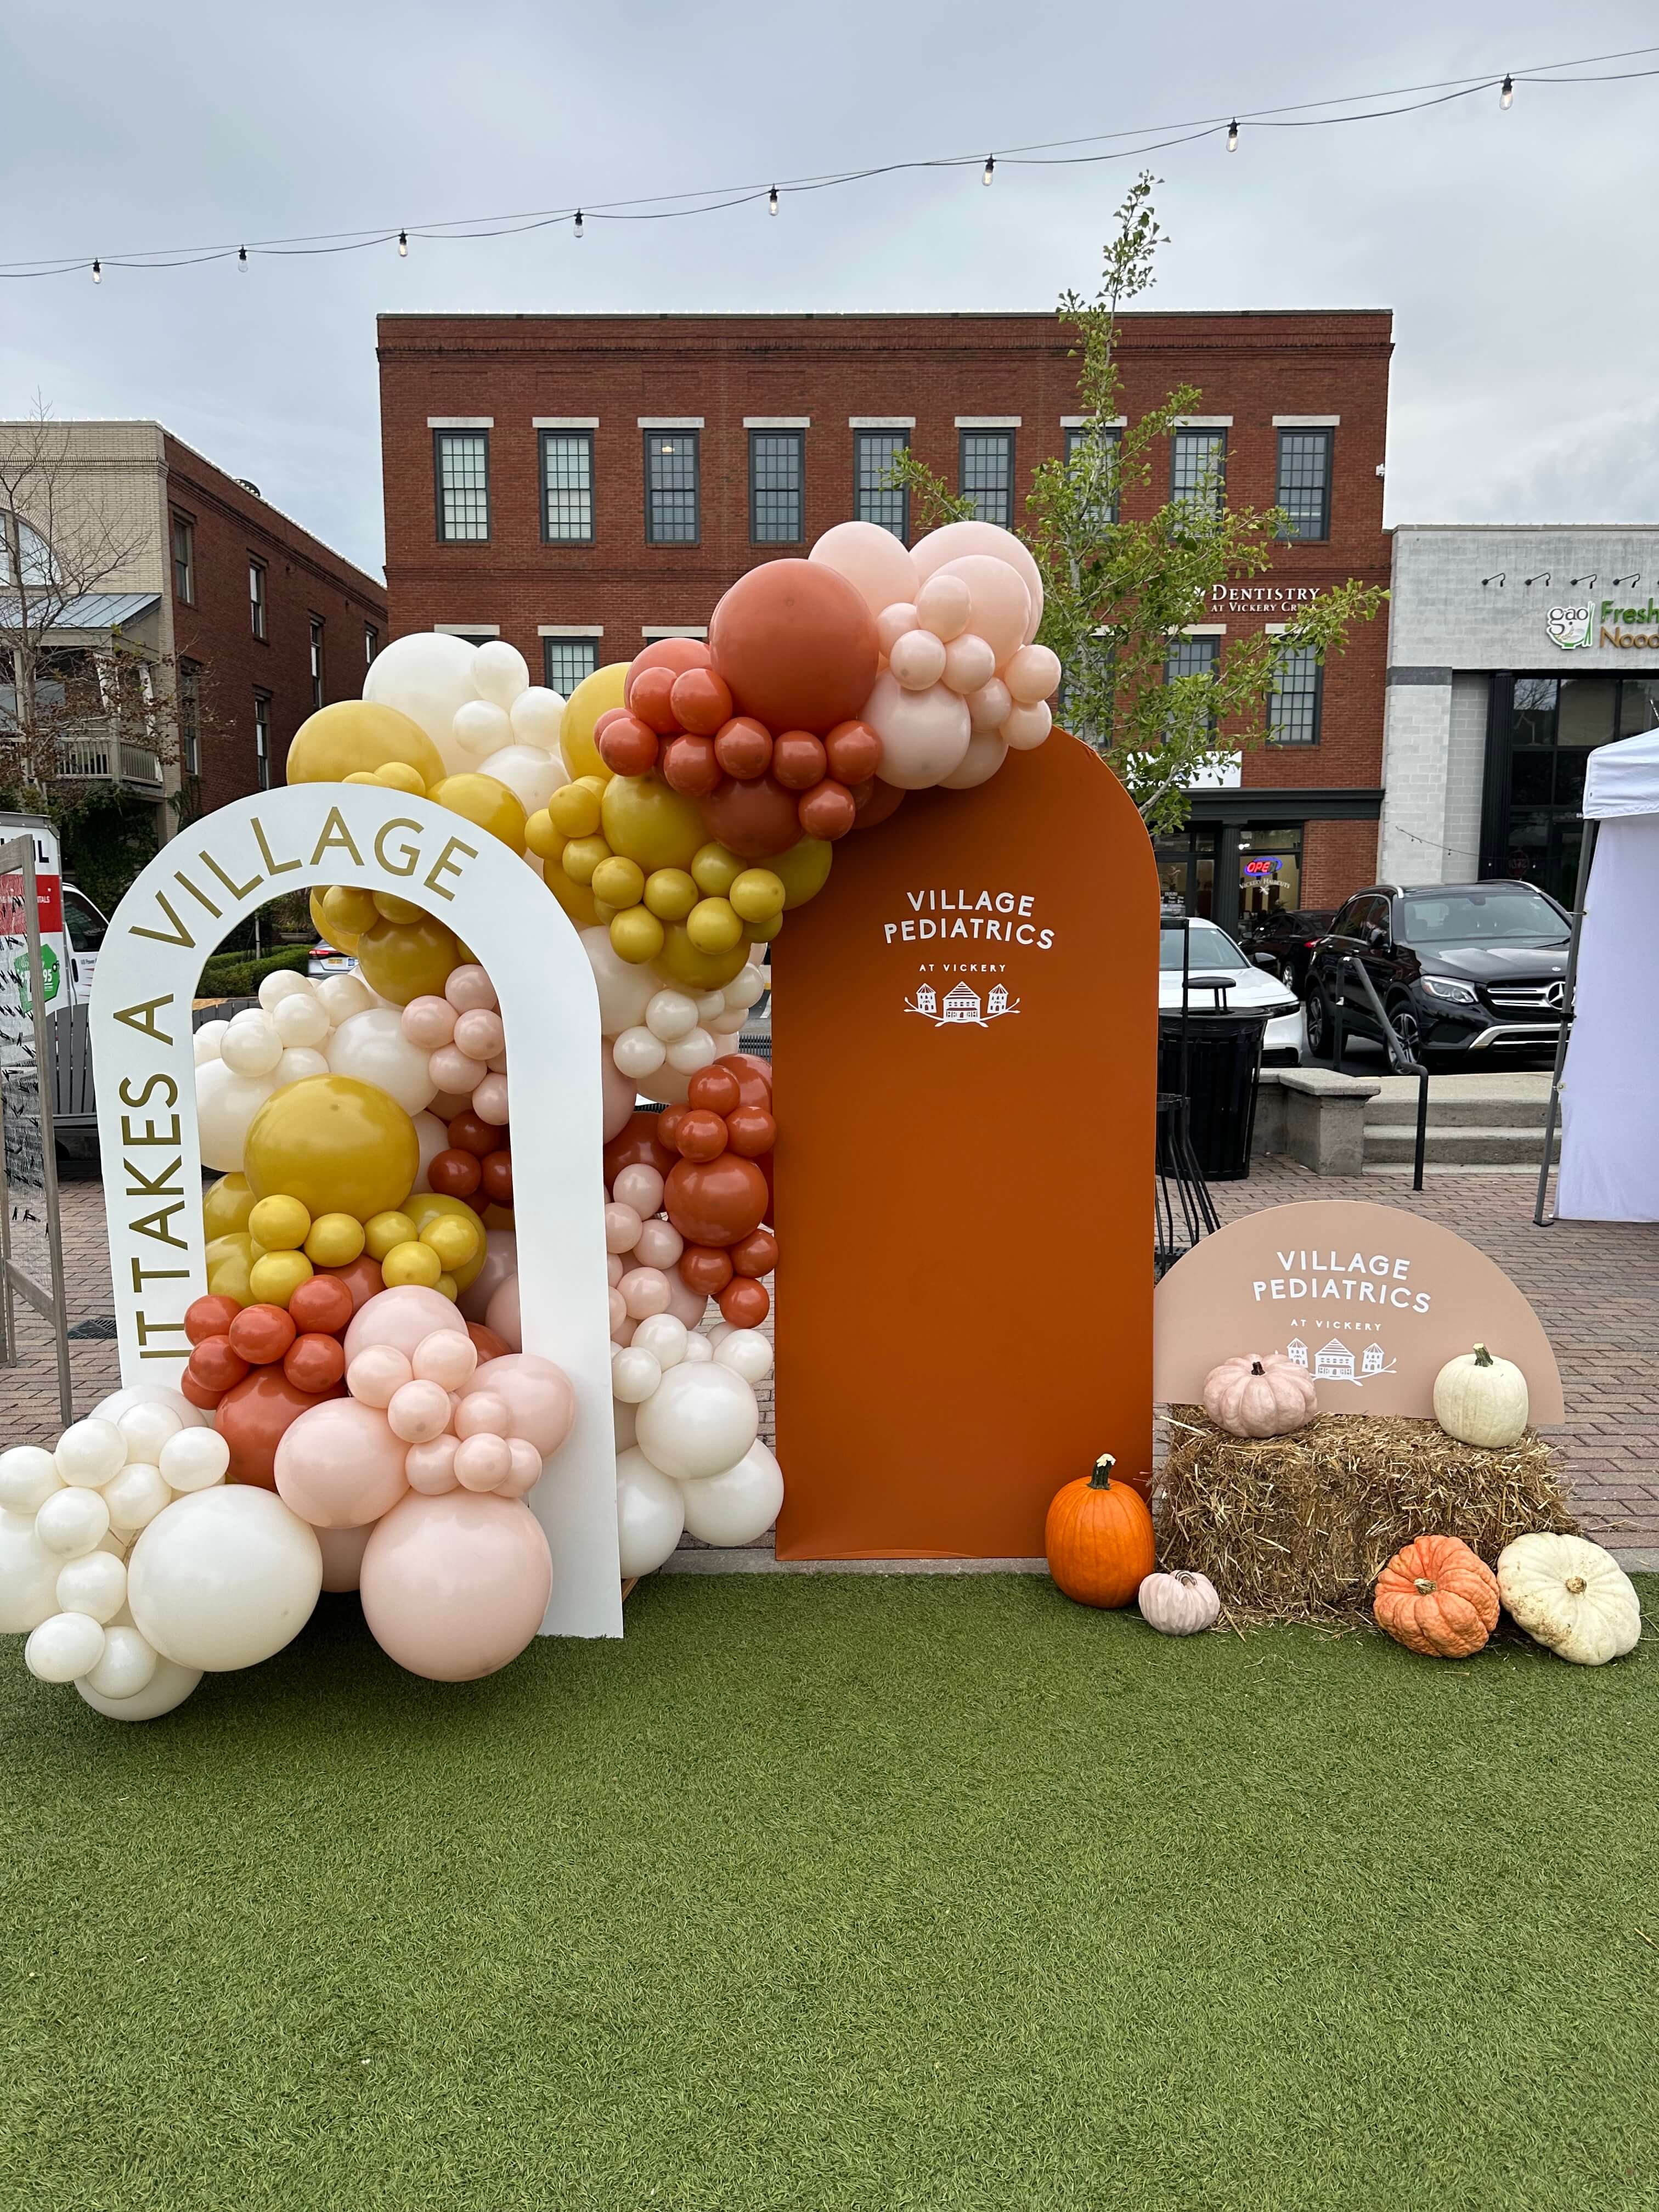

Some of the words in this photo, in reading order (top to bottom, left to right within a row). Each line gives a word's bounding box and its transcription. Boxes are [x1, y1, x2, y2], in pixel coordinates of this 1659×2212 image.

[1211, 584, 1320, 601] DENTISTRY
[1229, 602, 1276, 612] VICKERY
[1281, 602, 1317, 612] CRK
[128, 806, 478, 949] VILLAGE
[906, 889, 1035, 917] VILLAGE
[884, 918, 1055, 949] PEDIATRICS
[943, 964, 1006, 972] VICKERY
[114, 993, 174, 1046] A
[119, 1073, 190, 1293] TAKES
[1277, 1250, 1410, 1281] VILLAGE
[1253, 1278, 1431, 1313] PEDIATRICS
[135, 1310, 194, 1359] IT
[1290, 1318, 1307, 1327] AT
[1316, 1320, 1382, 1331] VICKERY
